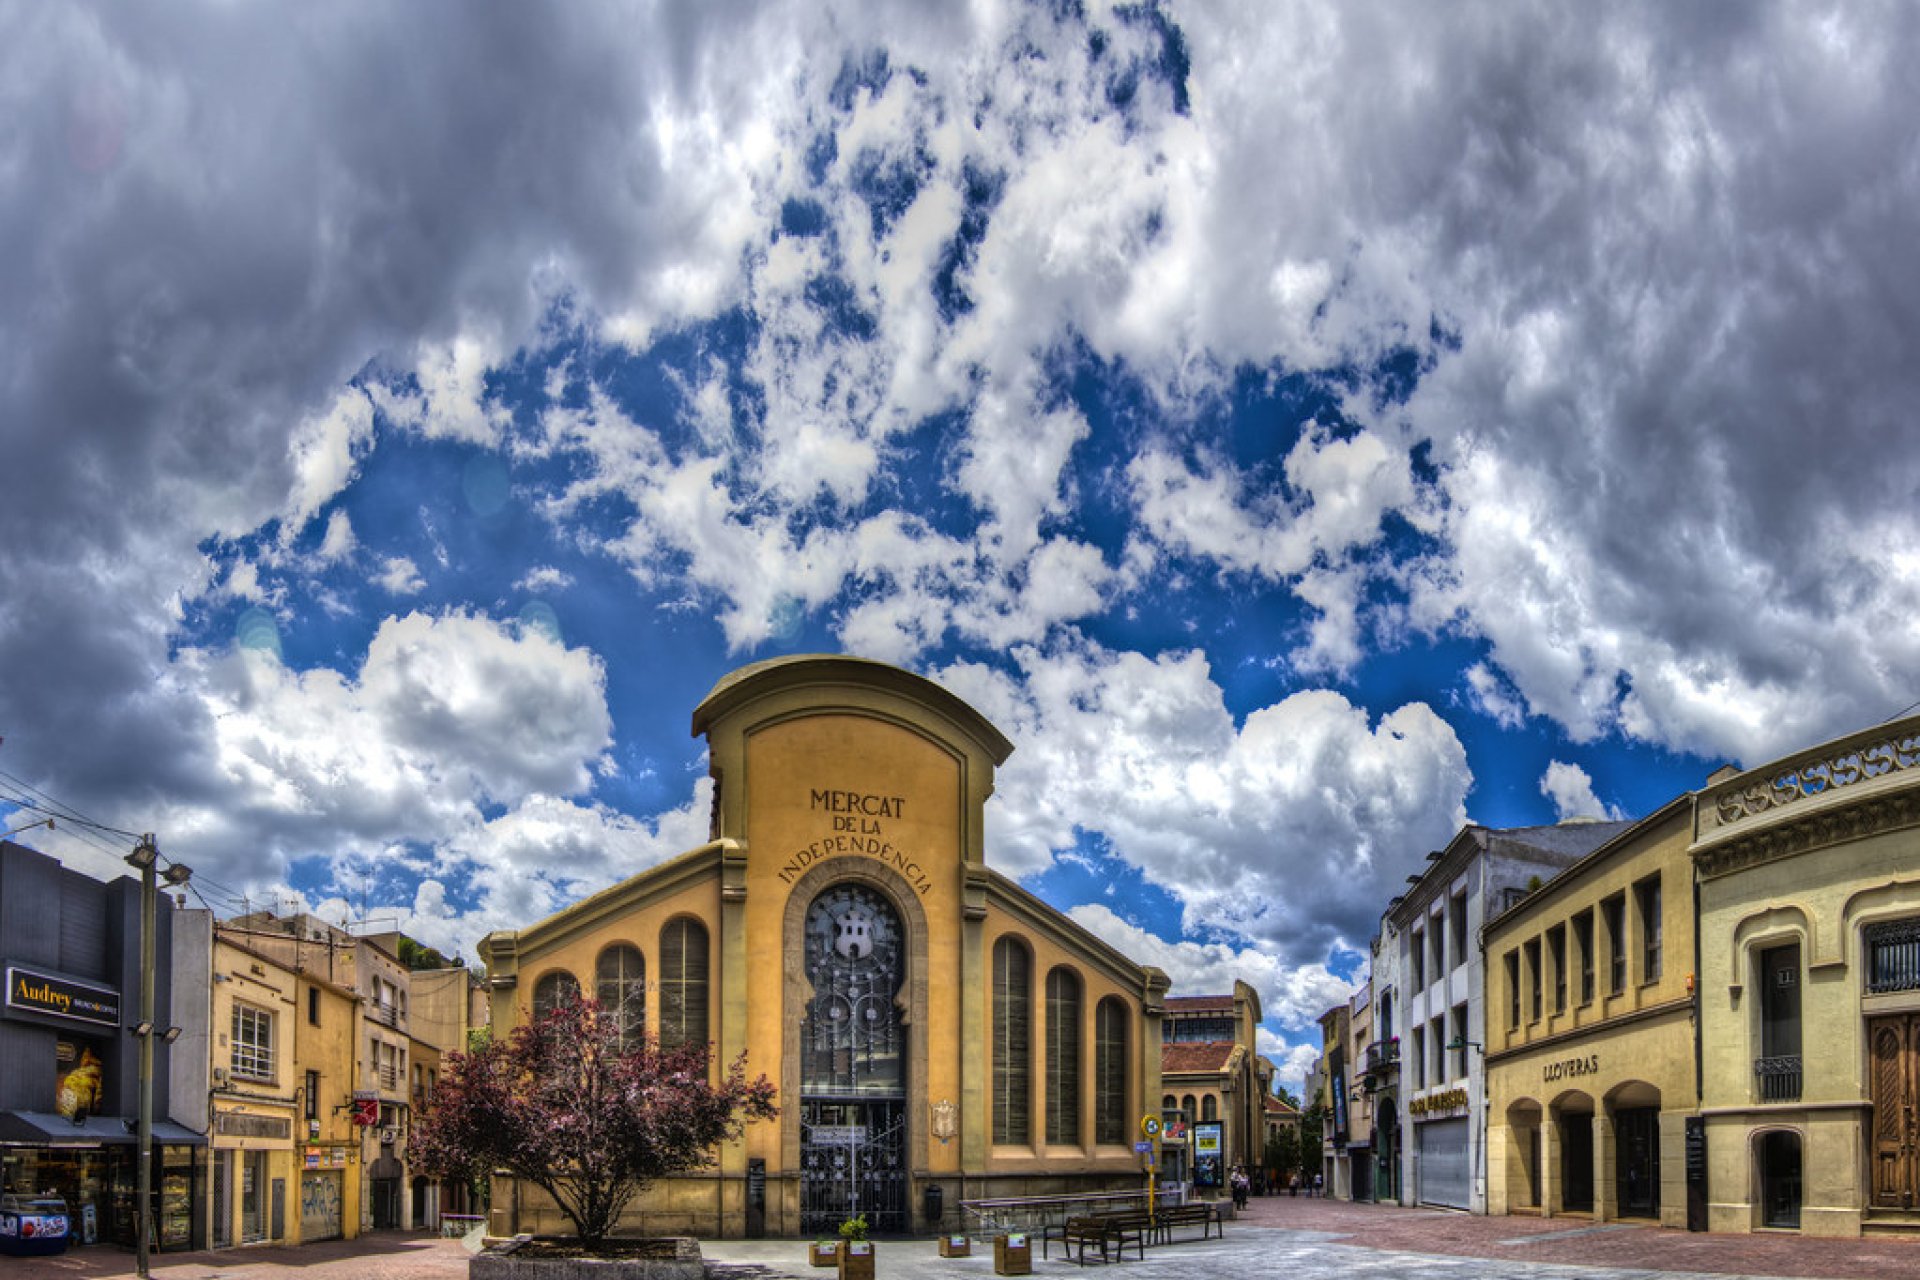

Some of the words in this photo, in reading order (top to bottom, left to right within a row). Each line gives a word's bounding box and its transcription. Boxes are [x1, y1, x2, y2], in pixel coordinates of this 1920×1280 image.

[810, 788, 905, 819] MERCAT
[833, 816, 857, 833] DE
[861, 818, 881, 835] LA
[778, 836, 932, 895] INDEPENDENCIA
[16, 978, 71, 1013] Audrey
[1543, 1054, 1599, 1083] LLOVERAS
